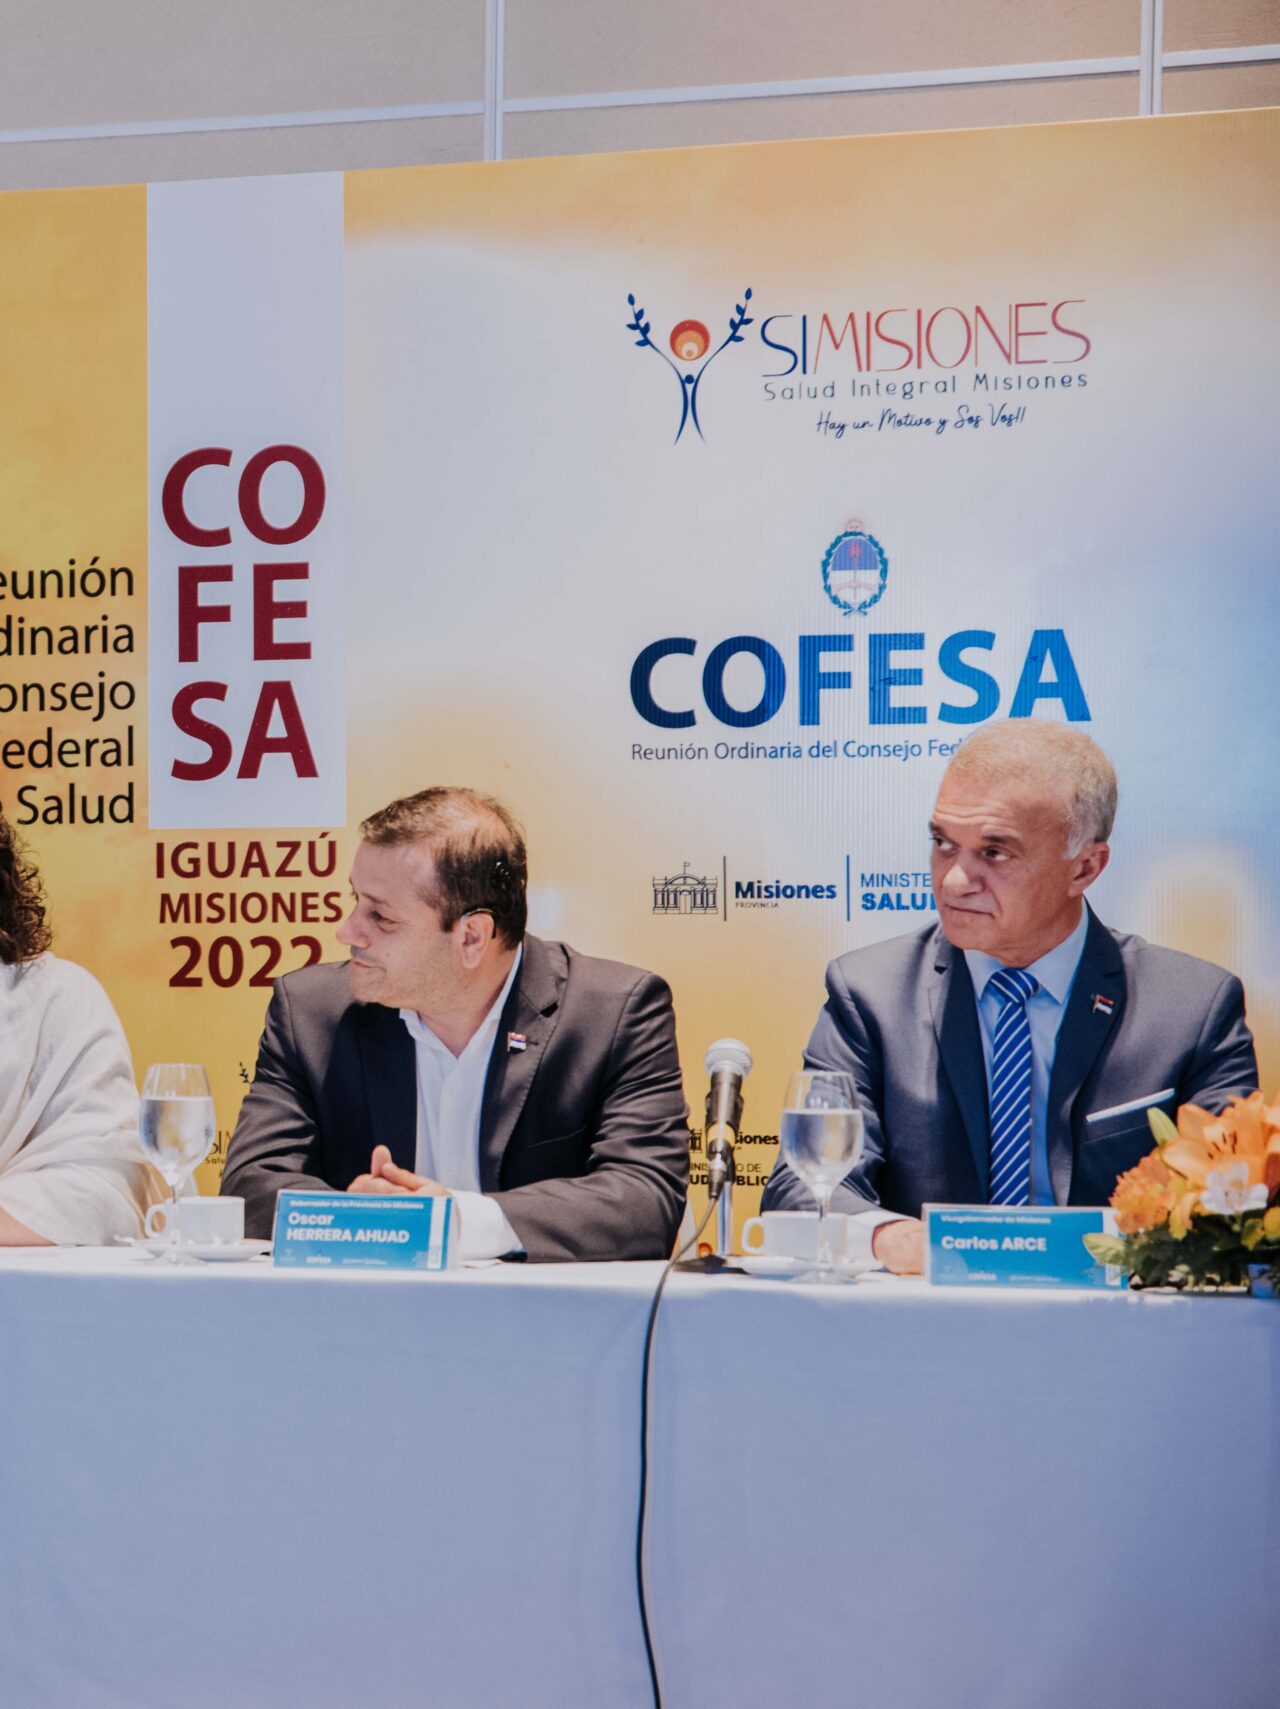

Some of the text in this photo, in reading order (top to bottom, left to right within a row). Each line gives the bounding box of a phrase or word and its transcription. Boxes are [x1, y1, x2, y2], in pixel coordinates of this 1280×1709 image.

[761, 300, 1091, 377] SIMISIONES
[763, 372, 1088, 401] Salud Integral Misiones
[817, 411, 847, 438] Hay
[878, 408, 934, 432] Motivo
[936, 420, 949, 435] y
[953, 404, 983, 429] Sos
[162, 444, 326, 547] CO
[178, 562, 312, 663] FE
[630, 629, 1092, 729] COFESA
[171, 680, 320, 782] SA
[631, 743, 709, 761] Reunión
[713, 740, 803, 760] Ordinaria
[808, 740, 839, 758] del
[843, 738, 922, 761] Consejo
[16, 782, 134, 825] Salud
[156, 832, 336, 879] IGUAZÚ
[735, 880, 837, 899] Misiones
[861, 872, 932, 888] MINISTE
[159, 891, 343, 924] MISIONES
[288, 1212, 334, 1224] Oscar
[287, 1228, 410, 1242] HERRERA AHUAD
[942, 1236, 1047, 1251] Carlos ARCE
